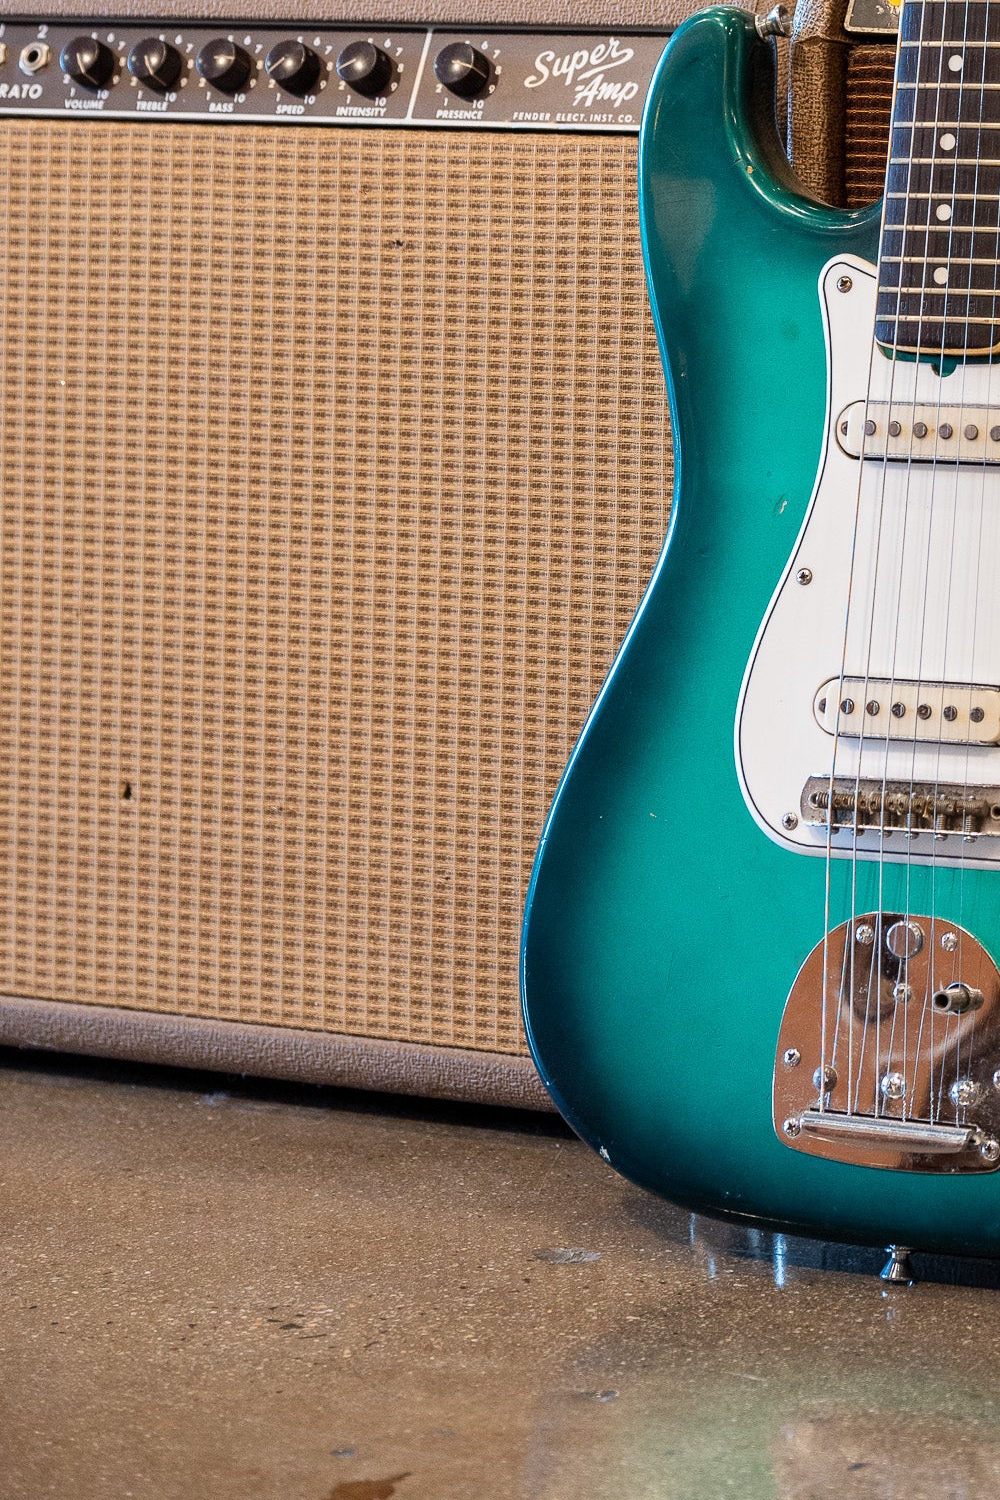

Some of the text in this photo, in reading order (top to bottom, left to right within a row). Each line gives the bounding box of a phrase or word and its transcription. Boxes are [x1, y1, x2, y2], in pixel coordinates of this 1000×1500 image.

[37, 25, 49, 39] 2
[523, 36, 634, 88] Super
[572, 73, 639, 108] Amp
[64, 100, 105, 110] VOLUME
[136, 101, 168, 111] TREBLE
[209, 103, 234, 113] BASS
[276, 104, 305, 115] SPEED
[336, 106, 387, 117] INTENSITY
[436, 109, 483, 120] PRESENCE
[512, 111, 635, 123] FENDER ELECT. INST. CO.
